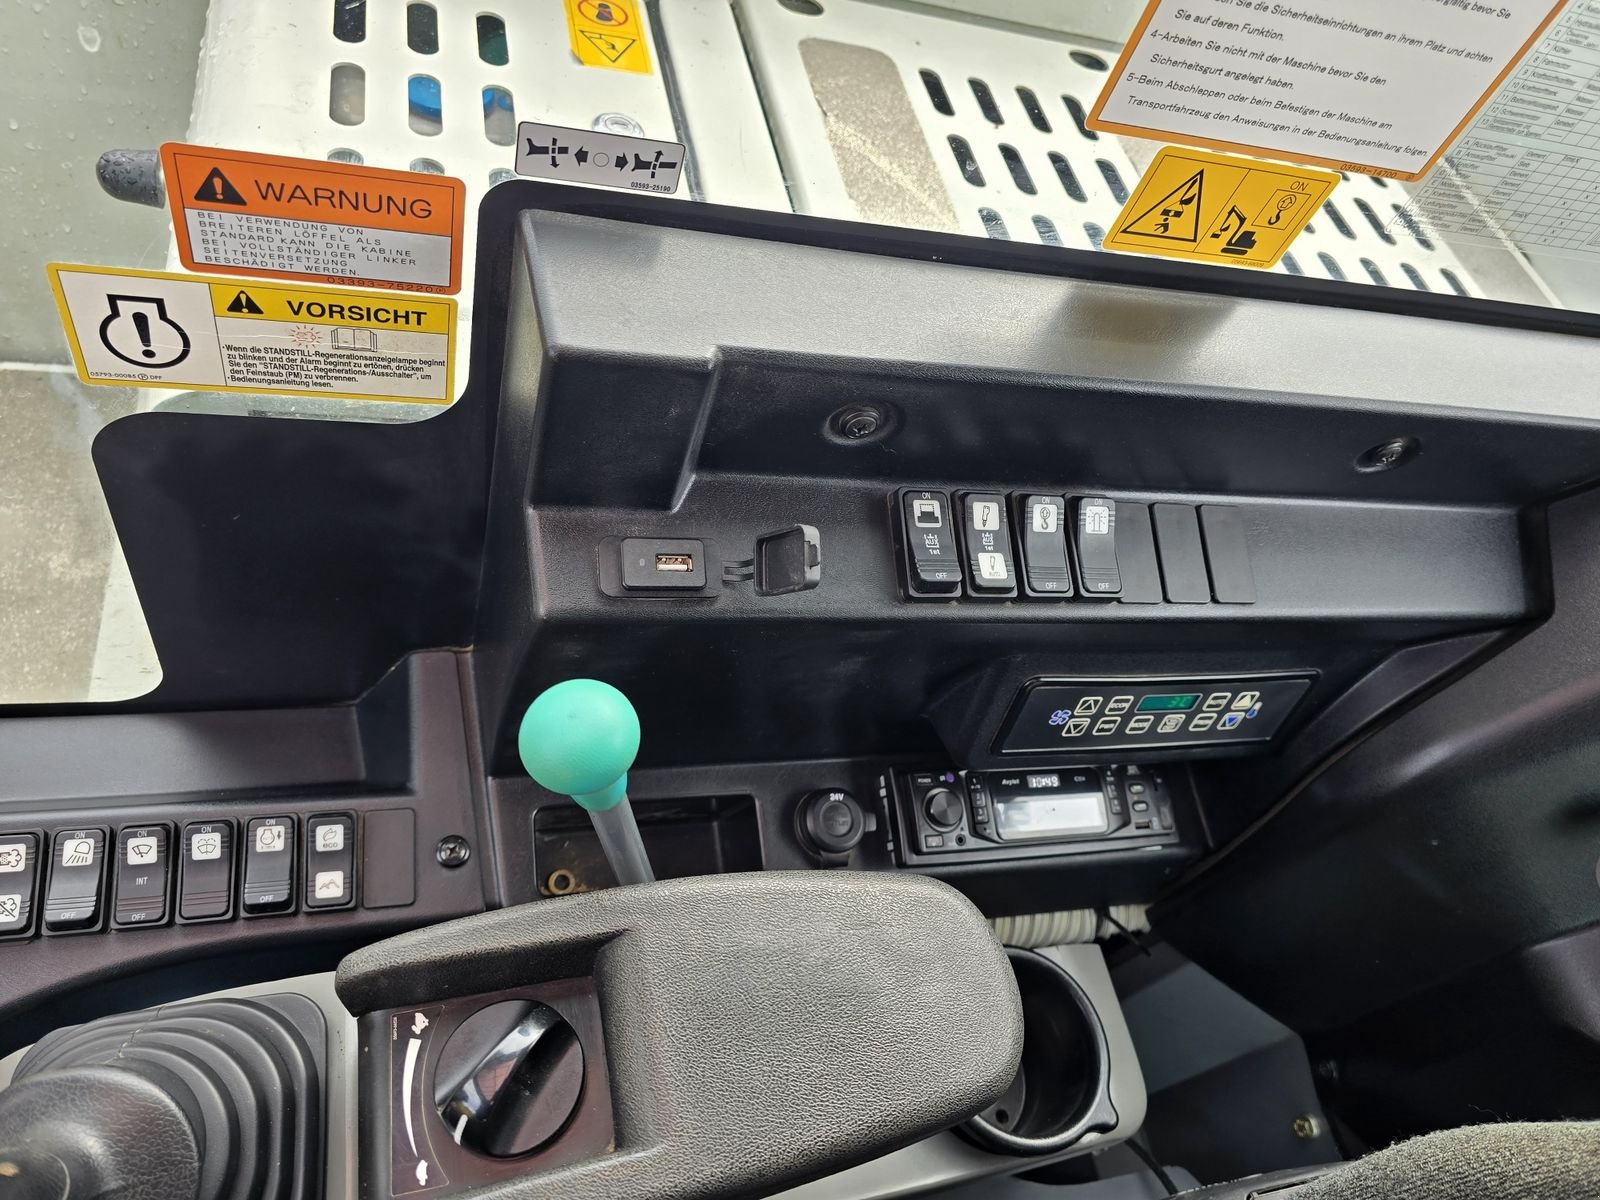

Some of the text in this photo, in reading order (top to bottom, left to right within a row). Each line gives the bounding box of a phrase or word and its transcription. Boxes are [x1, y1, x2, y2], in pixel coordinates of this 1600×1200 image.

[1175, 9, 1191, 21] Sie
[1193, 15, 1212, 25] auf
[1211, 18, 1239, 31] deren
[1471, 2, 1496, 15] bevor
[1496, 8, 1511, 20] Sie
[1254, 1, 1269, 13] die
[1271, 4, 1383, 38] Sicherheitseinrichtungen
[1385, 33, 1396, 42] an
[1398, 34, 1422, 48] ihrem
[1424, 40, 1446, 52] Platz
[1447, 47, 1465, 57] und
[1464, 51, 1493, 63] achten
[1150, 30, 1386, 86] 4-Arbeiten Sie nicht mit der Maschine bevor Sie den
[1150, 54, 1294, 90] Sicherheitsgurt angelegt haben.
[1126, 73, 1163, 87] 5-Beim
[1165, 80, 1225, 99] Abschleppen
[1227, 94, 1250, 104] oder
[1250, 96, 1272, 108] beim
[1274, 100, 1320, 116] Befestigen
[1321, 109, 1336, 118] der
[1337, 112, 1378, 127] Maschine
[1127, 95, 1212, 119] Transportfahrzeug
[1213, 112, 1230, 121] den
[1232, 115, 1290, 132] Anweisungen
[1292, 125, 1300, 134] in
[1302, 127, 1317, 136] der
[1317, 130, 1402, 153] Bedienungsanleitung
[631, 181, 671, 192] 03593-25190
[1290, 181, 1308, 191] ON
[254, 180, 432, 218] WARNUNG
[198, 211, 364, 235] BEI VERWENDUNG VON
[199, 221, 381, 246] BREITEREN LÖFFEL ALS
[201, 230, 412, 257] STANDARD KANN DIE KABINE
[204, 247, 348, 266] SEITENVERSETZUNG
[240, 242, 356, 259] VOLLSTÄNDIGER
[367, 255, 416, 266] LINKER
[205, 255, 360, 276] BESCHÄDIGT WERDEN.
[327, 277, 433, 292] 03393-75220
[287, 301, 427, 326] VORSICHT
[264, 347, 417, 365] STANDSTILL-Regenerationsanzeigelampe
[419, 358, 445, 367] beginnt
[324, 360, 351, 368] beginnt
[364, 362, 394, 371] ertönen,
[396, 364, 424, 372] drücken
[231, 375, 309, 388] Bedienungsanleitung
[246, 369, 283, 378] Feinstaub
[286, 371, 302, 380] (PM)
[315, 373, 358, 382] verbrennen.
[921, 492, 931, 500] ON
[1031, 776, 1058, 788] 10:49
[136, 877, 148, 885] INT
[60, 912, 76, 920] OFF
